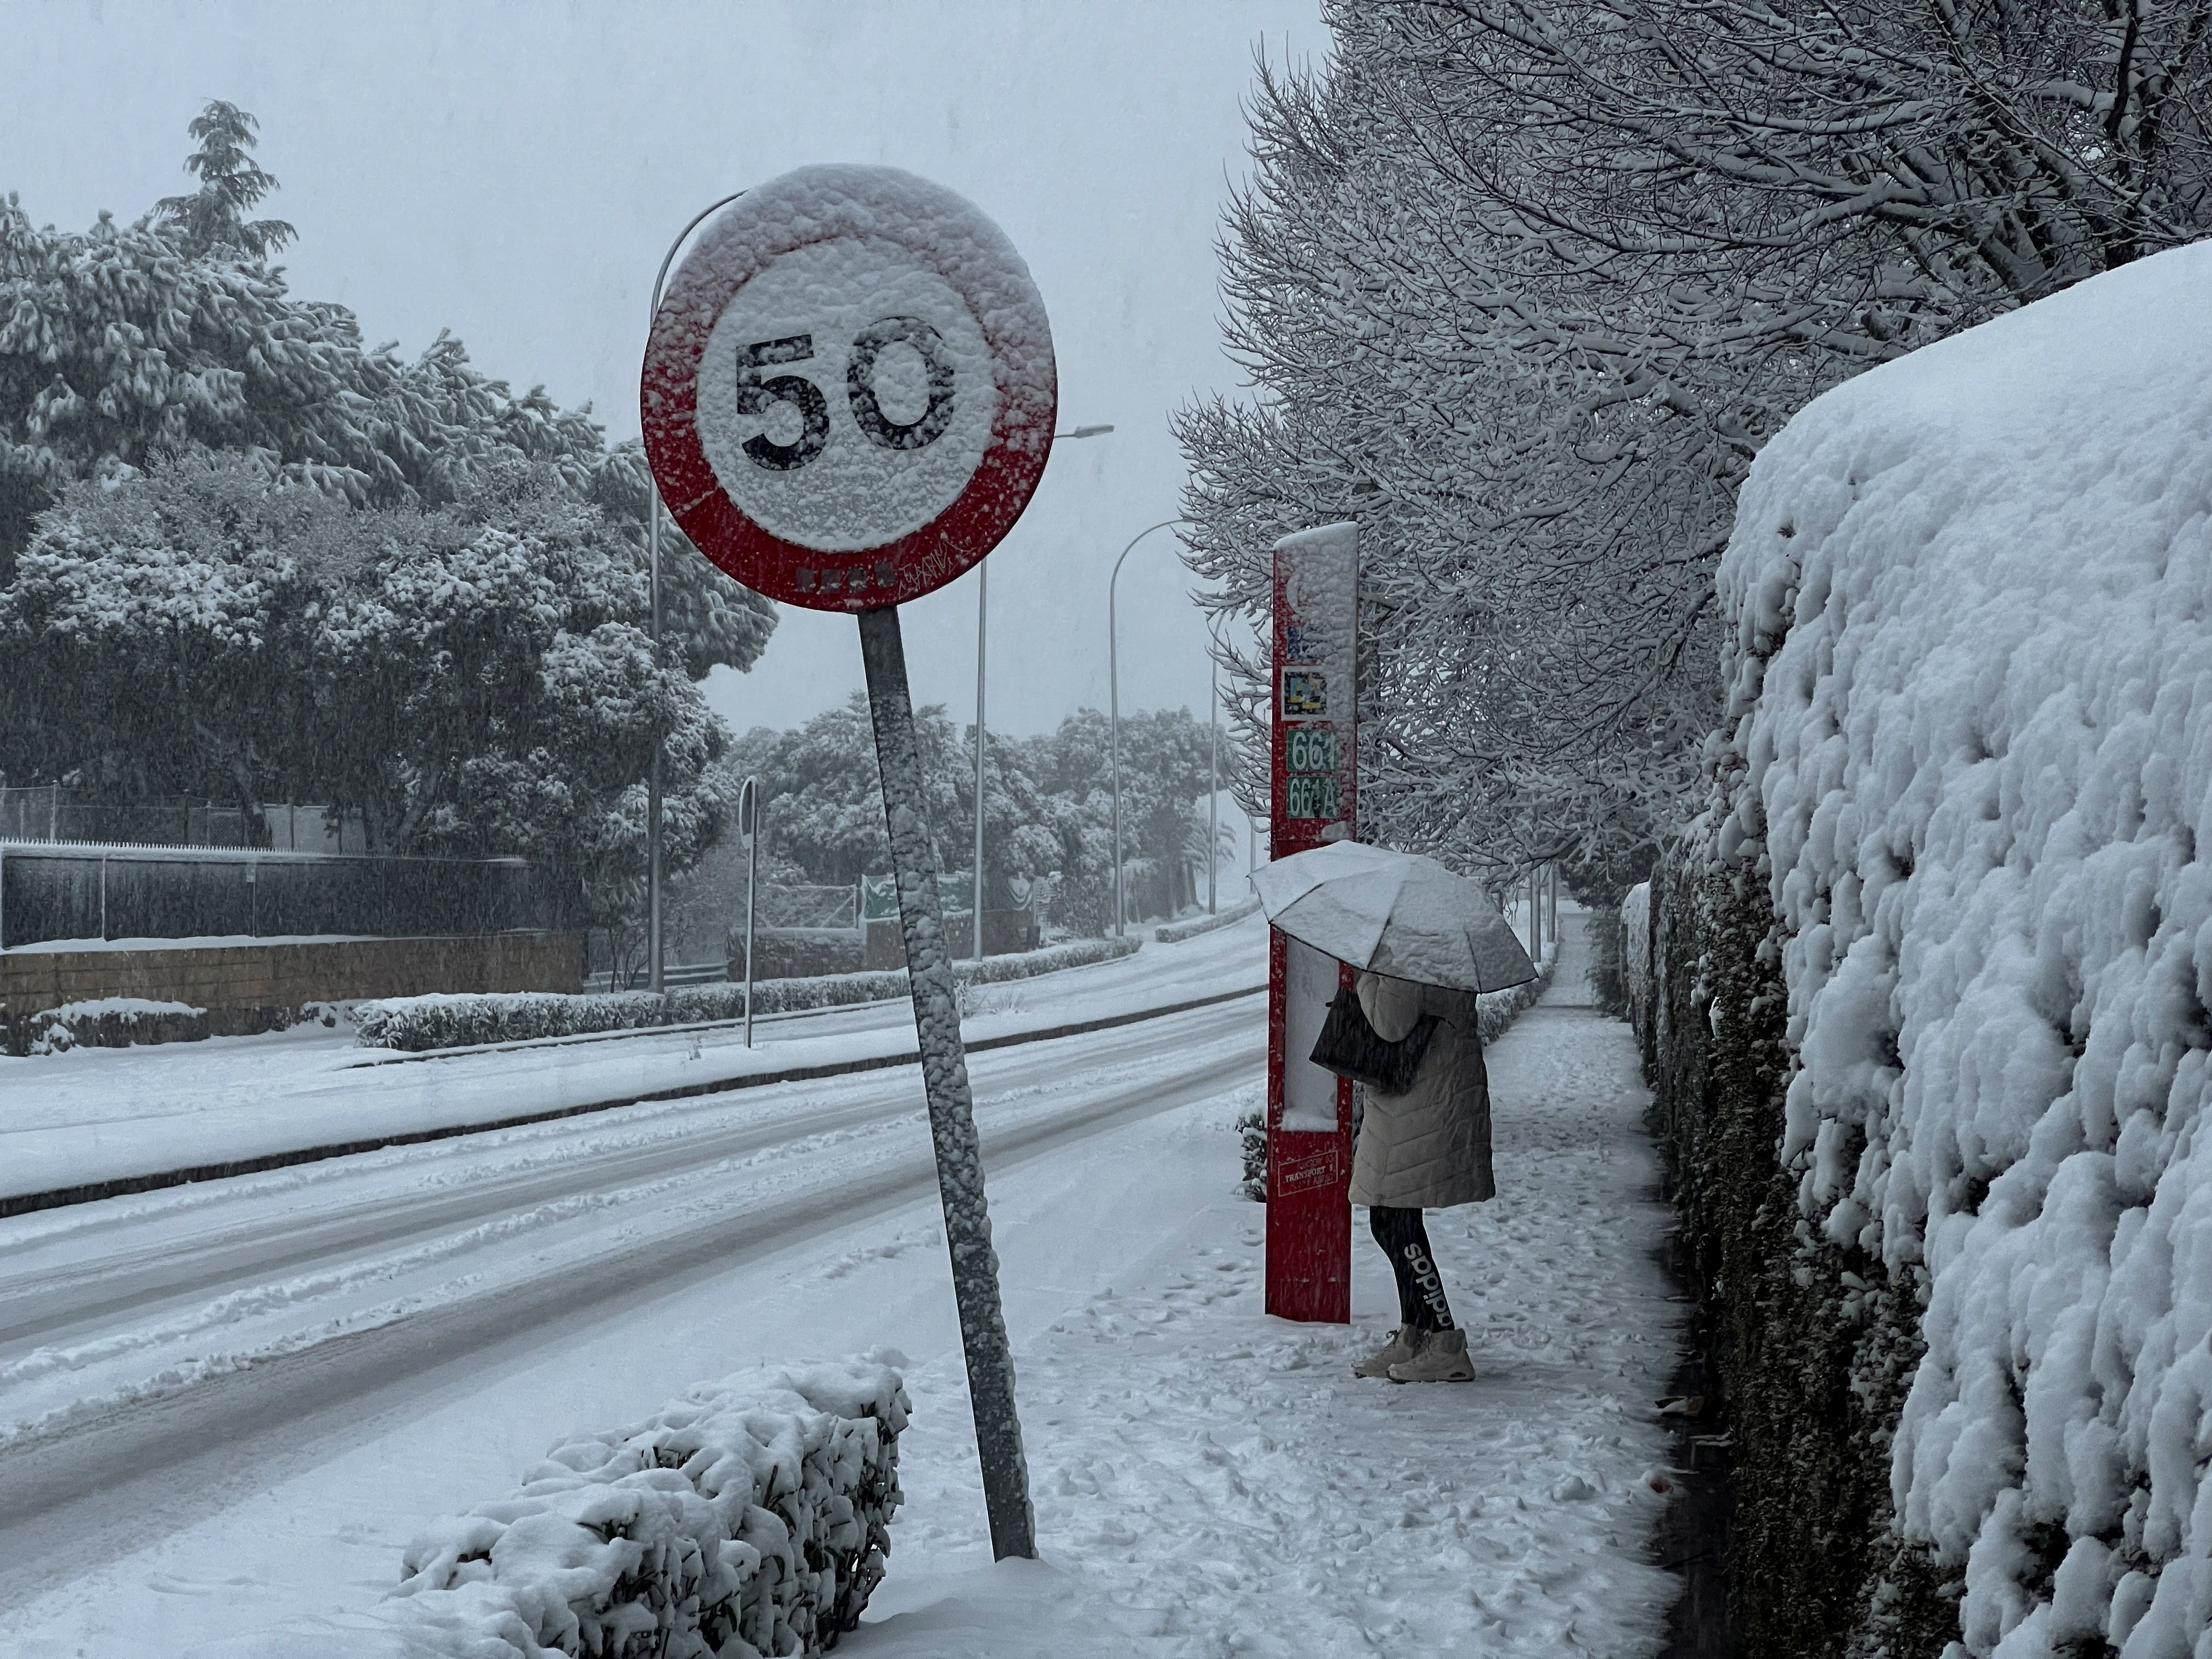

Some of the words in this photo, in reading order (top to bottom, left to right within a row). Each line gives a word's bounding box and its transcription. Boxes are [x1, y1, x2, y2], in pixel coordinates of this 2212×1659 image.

[736, 316, 955, 471] 50
[1293, 731, 1336, 770] 661
[1285, 1163, 1333, 1183] TRANSPORTS
[1404, 1243, 1452, 1327] adidas
